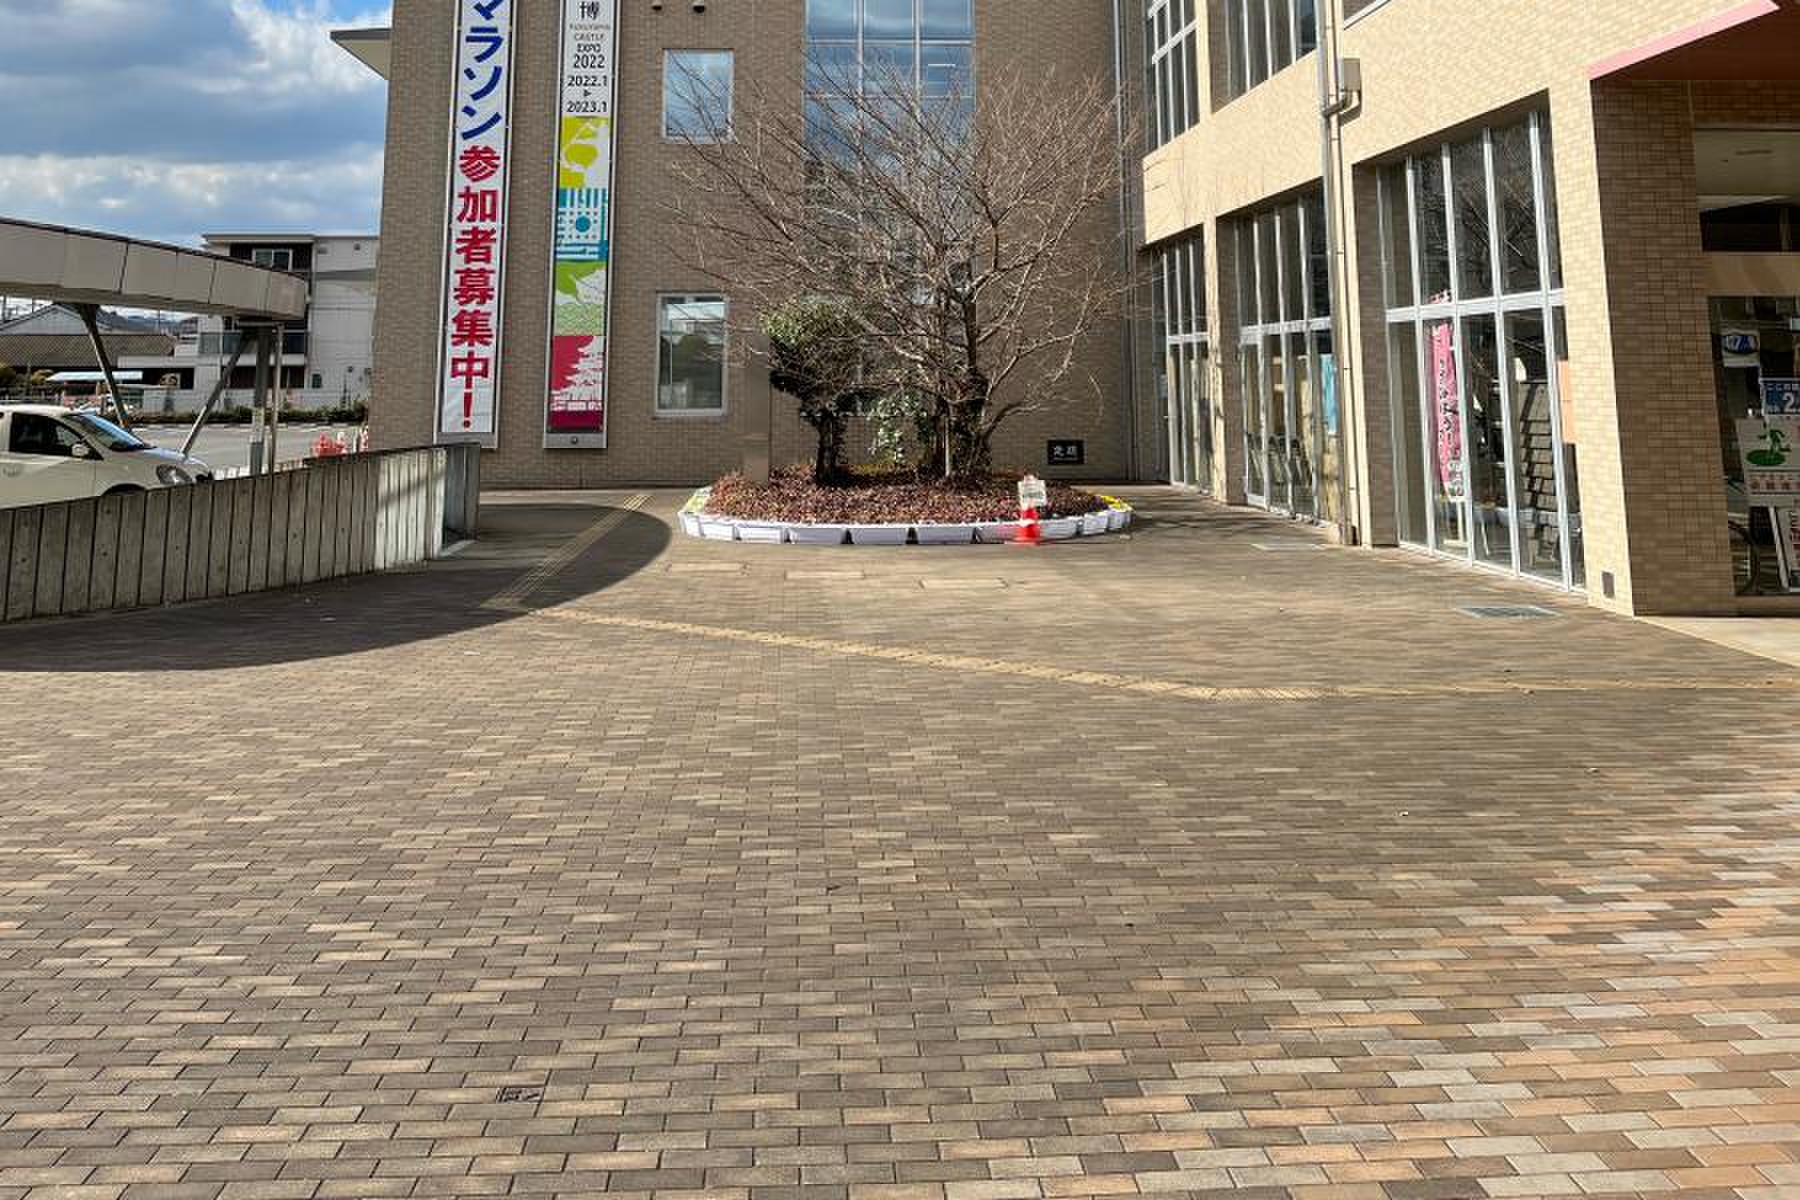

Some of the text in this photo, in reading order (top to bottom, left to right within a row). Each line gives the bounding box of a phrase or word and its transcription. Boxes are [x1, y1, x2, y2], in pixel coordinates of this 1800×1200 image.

[577, 43, 602, 53] EXPO
[573, 54, 606, 69] 2022
[567, 75, 608, 87] 2022.1
[566, 100, 608, 113] 2023.1
